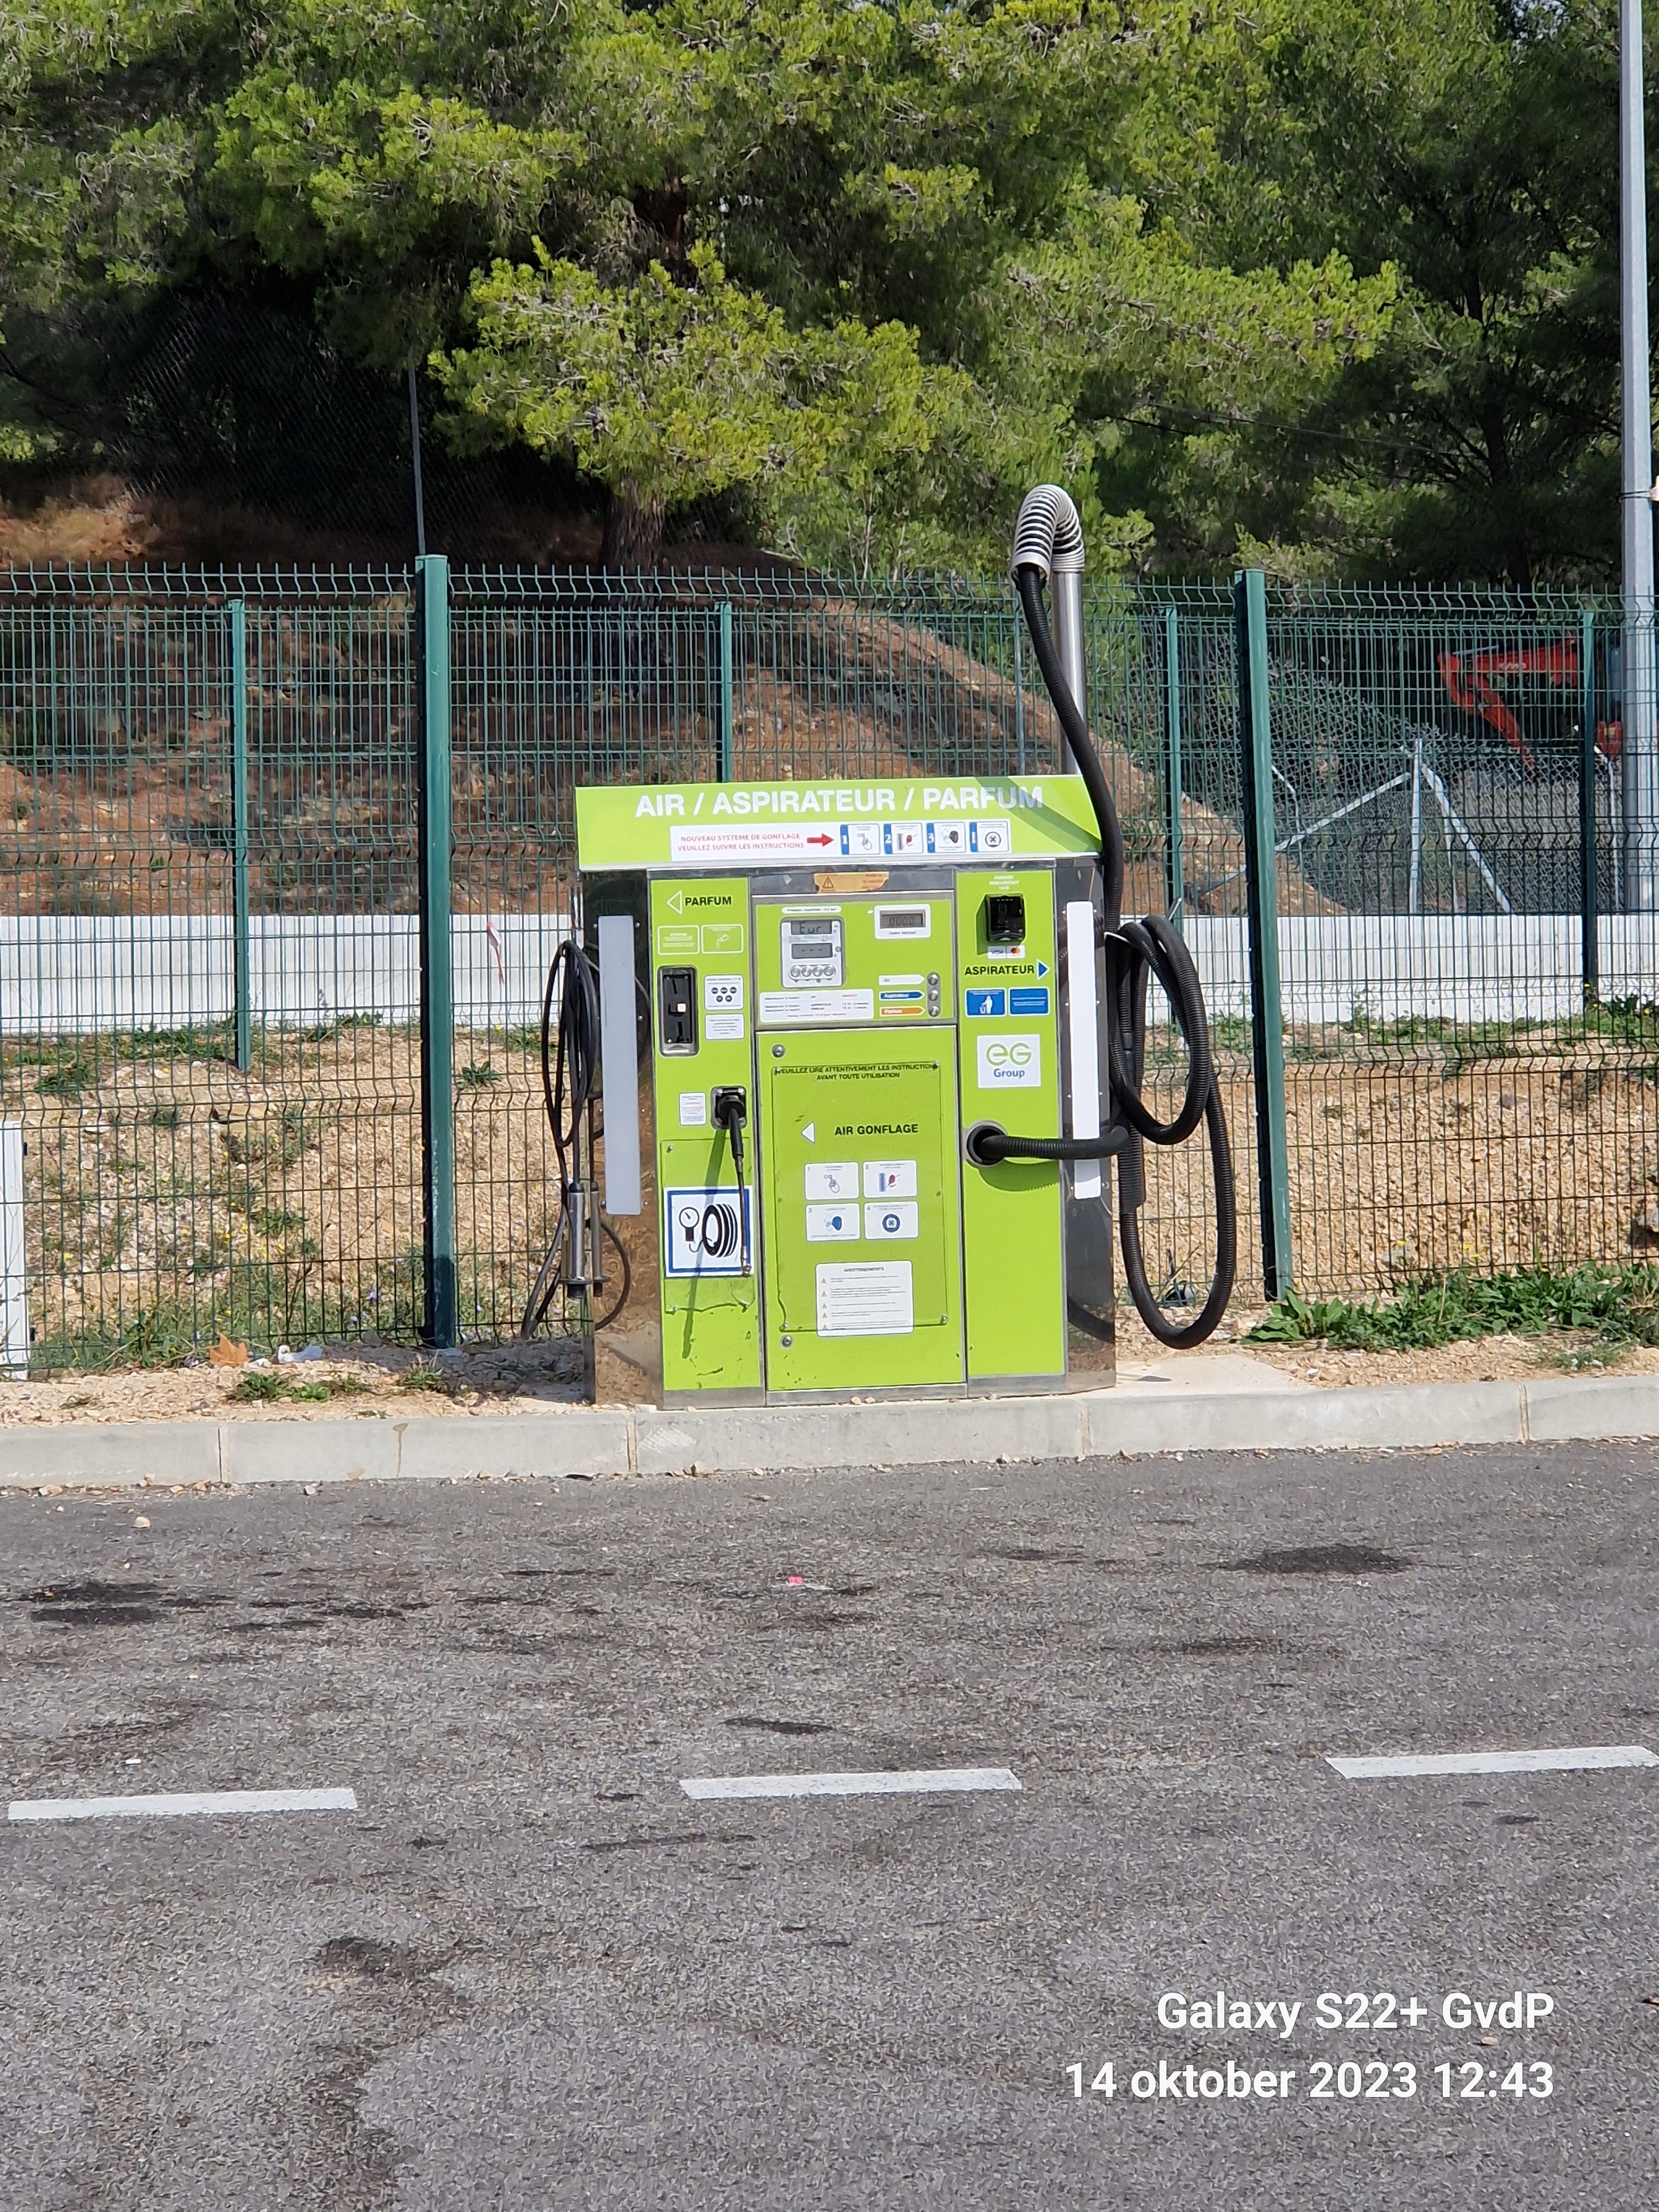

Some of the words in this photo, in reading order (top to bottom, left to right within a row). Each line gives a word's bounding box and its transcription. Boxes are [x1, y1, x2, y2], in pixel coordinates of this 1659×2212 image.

[635, 794, 685, 817] AIR
[693, 792, 705, 816] /
[712, 788, 895, 815] ASPIRATEUR
[903, 787, 915, 811] /
[923, 786, 1042, 810] PARFUM
[841, 834, 848, 844] 1
[885, 834, 891, 844] 2
[927, 833, 935, 843] 3
[685, 896, 732, 906] PARFUM
[964, 965, 1035, 975] ASPIRATEUR
[993, 1068, 1025, 1079] Group
[834, 1126, 853, 1135] AIR
[857, 1124, 919, 1135] GONFLAGE
